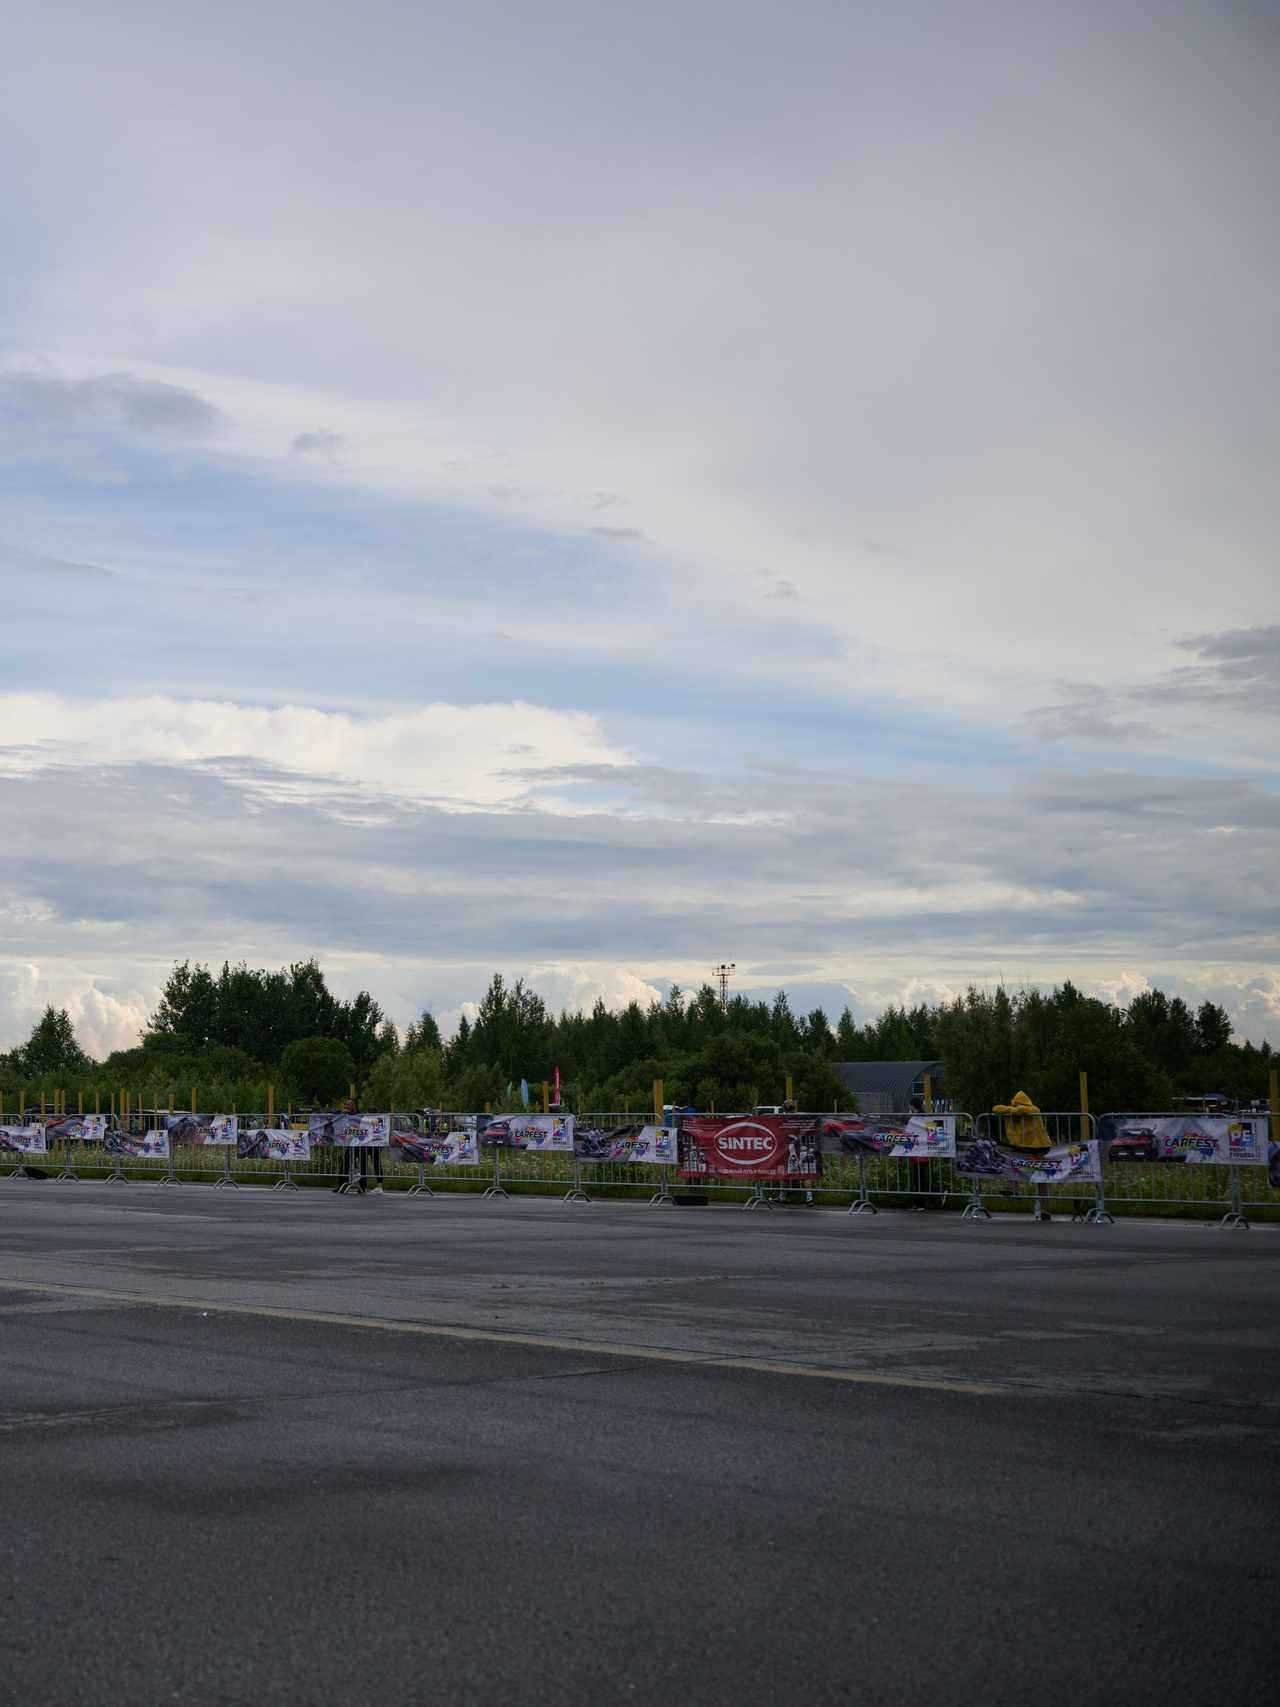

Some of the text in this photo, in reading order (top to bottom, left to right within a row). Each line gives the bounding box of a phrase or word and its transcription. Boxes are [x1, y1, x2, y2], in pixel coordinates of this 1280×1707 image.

[554, 1124, 565, 1134] PE
[929, 1126, 943, 1138] PE
[515, 1130, 548, 1139] CARFEST
[873, 1134, 920, 1143] CARFEST
[1231, 1129, 1251, 1142] PE
[459, 1139, 470, 1149] PE
[615, 1141, 650, 1149] CARFEST
[657, 1135, 668, 1146] PE
[718, 1136, 773, 1150] SINTEC
[1164, 1138, 1219, 1148] CARFEST
[422, 1146, 455, 1154] CARFEST
[1011, 1159, 1062, 1170] CARFEST
